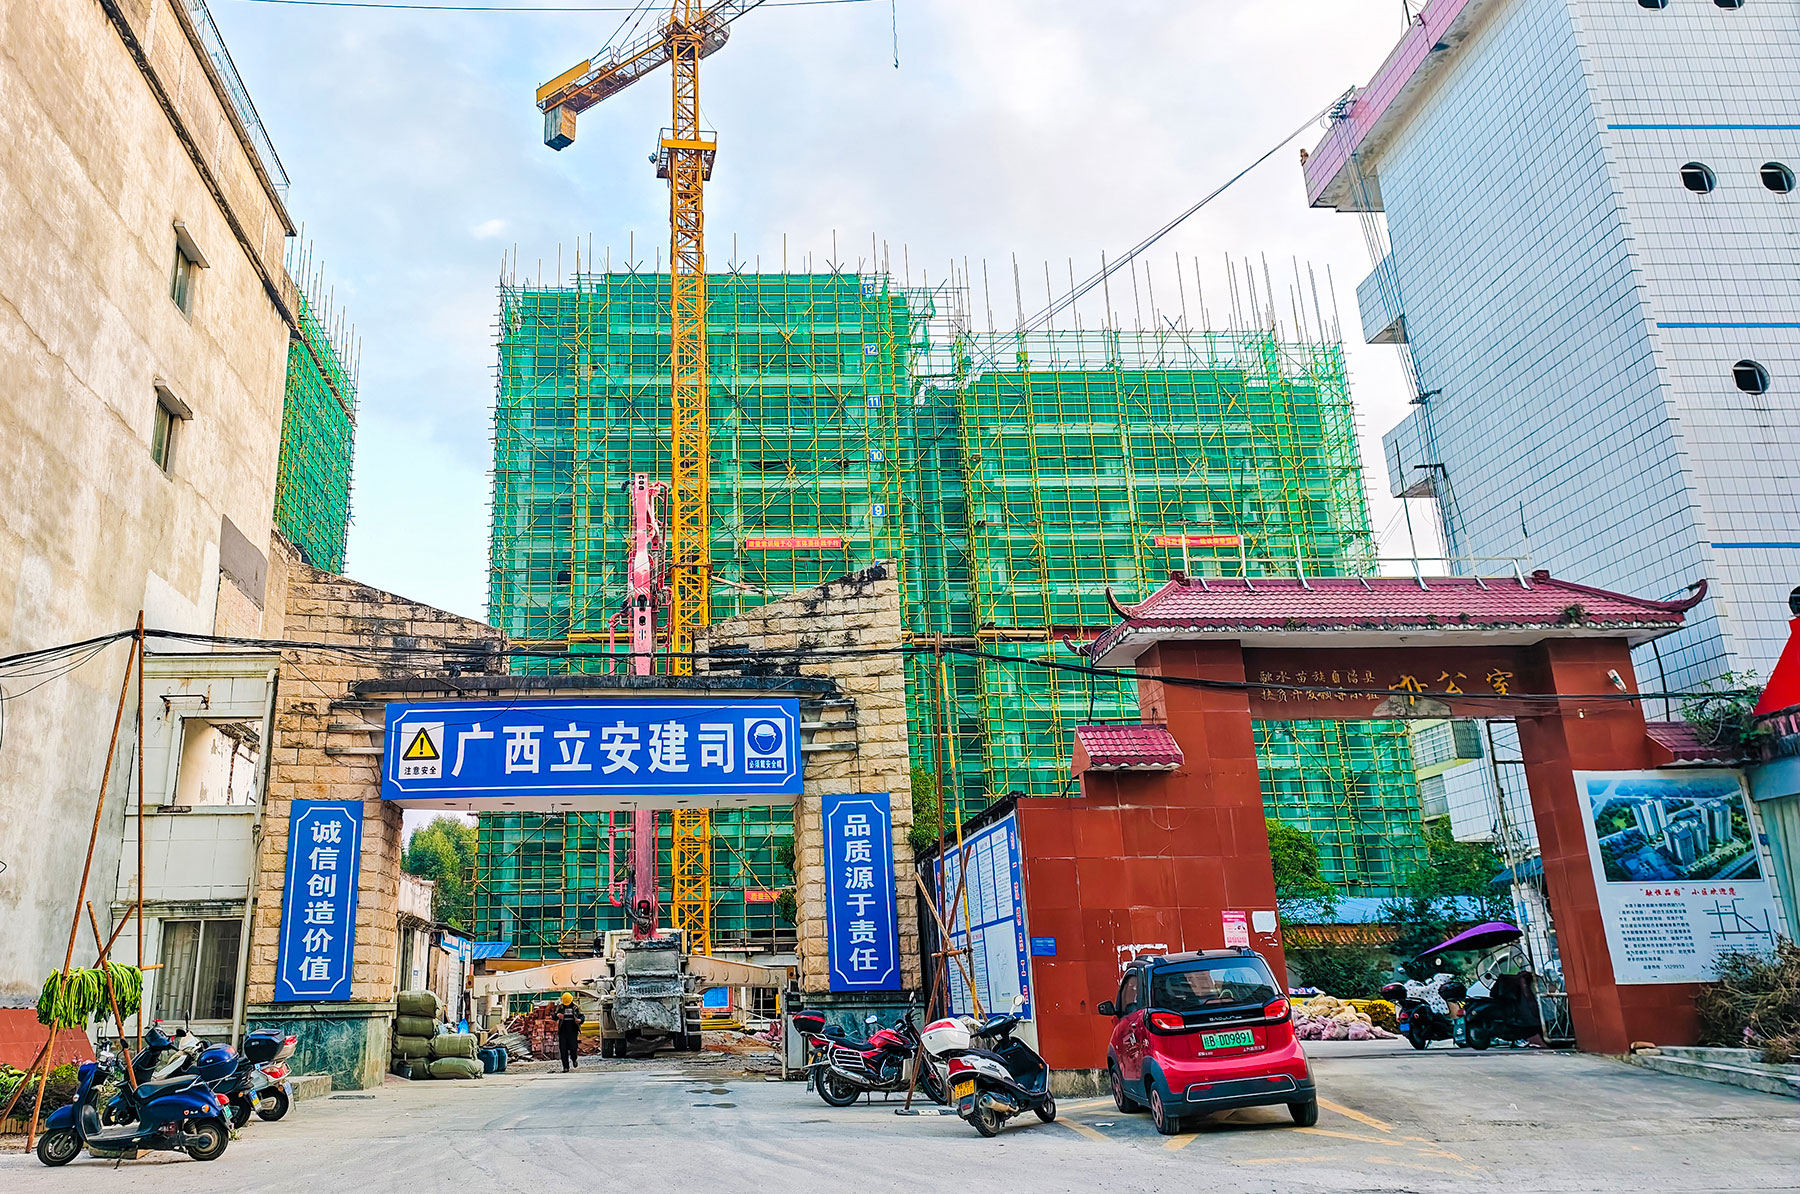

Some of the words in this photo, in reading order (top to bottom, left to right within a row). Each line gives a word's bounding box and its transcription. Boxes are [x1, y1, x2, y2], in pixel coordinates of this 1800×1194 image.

[864, 284, 874, 294] 13
[865, 345, 876, 354] 12
[869, 397, 880, 407] 11
[872, 451, 883, 460] 10
[874, 505, 882, 515] 9
[1259, 669, 1376, 684] 融水苗族自治县
[1388, 668, 1514, 706] 办公室
[451, 719, 735, 778] 广西立安建司
[404, 765, 437, 776] 注意安全
[843, 813, 880, 972] 品质源于责任
[298, 820, 342, 982] 诚信创造价值
